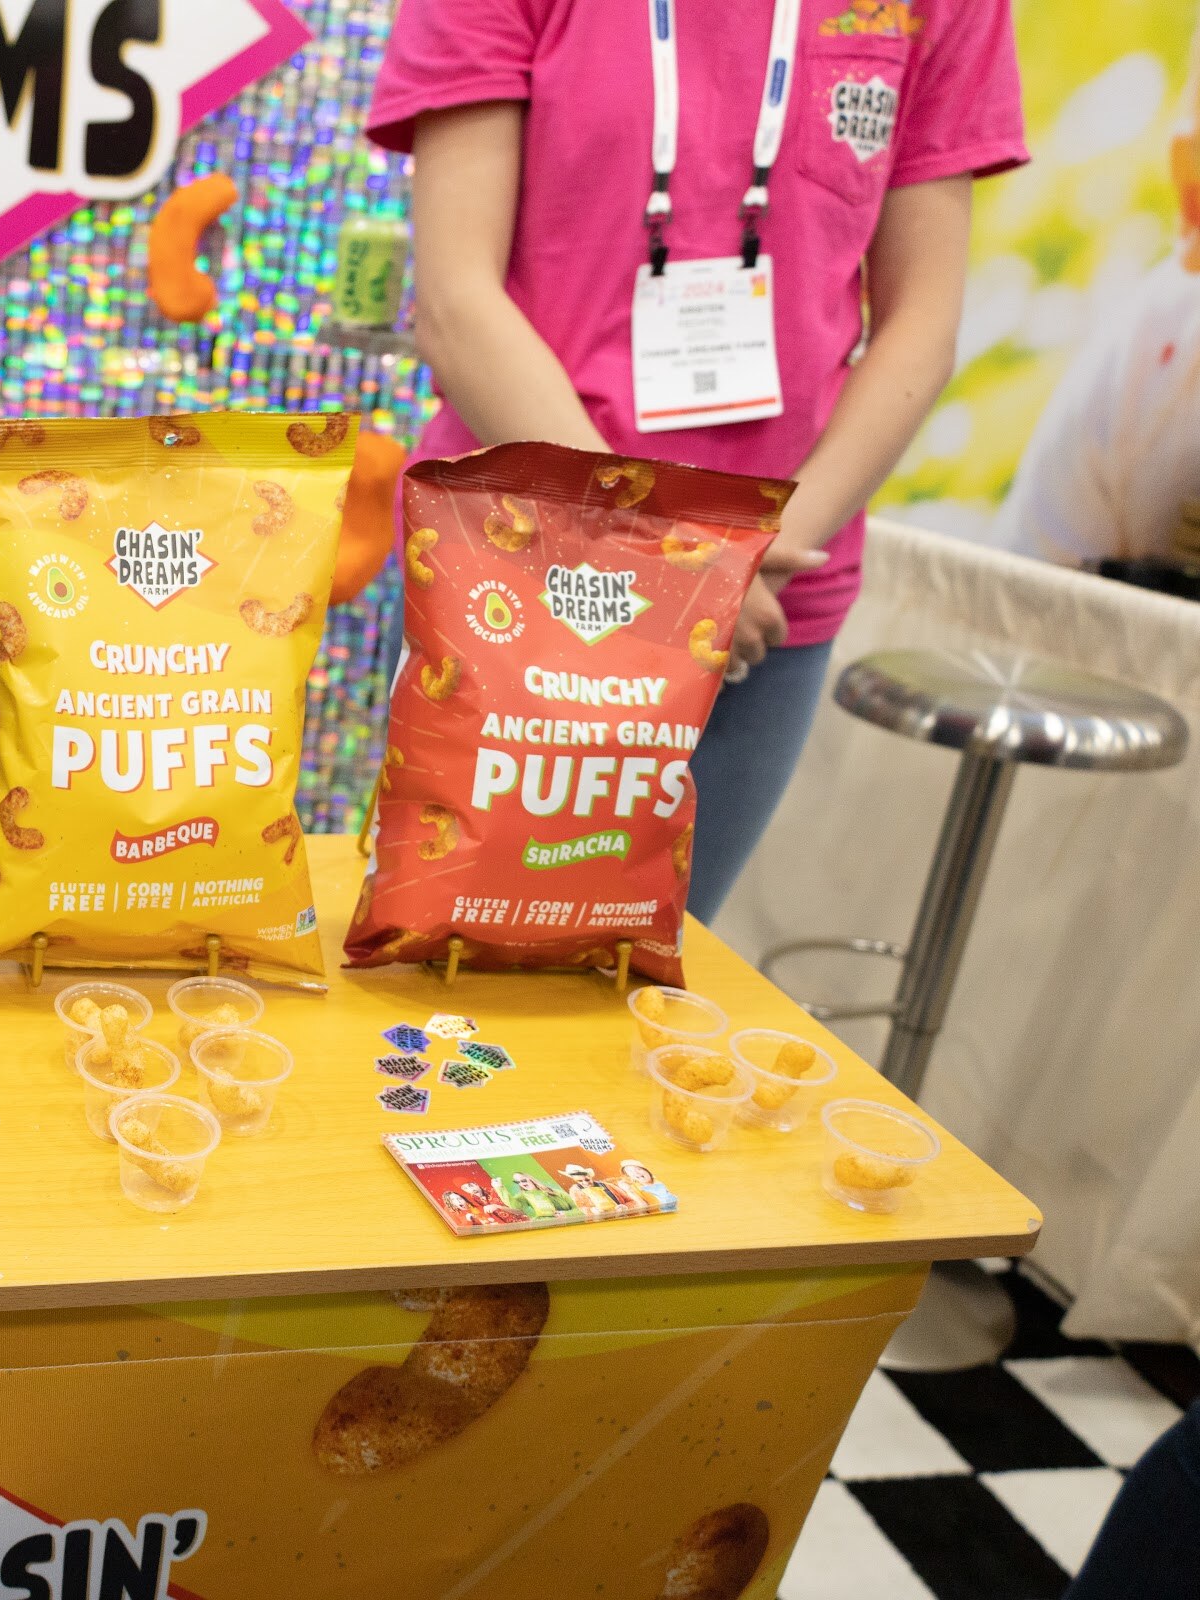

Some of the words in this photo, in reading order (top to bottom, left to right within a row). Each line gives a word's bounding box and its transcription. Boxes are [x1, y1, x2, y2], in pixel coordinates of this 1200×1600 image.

[115, 529, 201, 559] CHASIN'
[28, 553, 58, 577] MADE
[60, 553, 87, 580] WITH
[119, 560, 198, 585] DREAMS
[142, 587, 170, 596] FARM
[468, 580, 497, 601] MADE
[497, 581, 523, 609] WITH
[548, 567, 635, 599] CHASIN'
[27, 591, 76, 619] AVOCADO
[75, 595, 89, 611] OIL
[552, 599, 632, 624] DREAMS
[464, 614, 513, 644] AVOCADO
[512, 621, 526, 638] OIL
[575, 622, 602, 632] FARM
[89, 639, 231, 676] CRUNCHY
[524, 666, 668, 707] CRUNCHY
[55, 688, 172, 719] ANCIENT
[181, 687, 273, 716] GRAIN
[481, 712, 609, 748] ANCIENT
[617, 720, 700, 751] GRAIN
[51, 724, 273, 793] PUFFS
[470, 747, 690, 820] PUFFS
[115, 822, 214, 860] BARBEQUE
[526, 834, 626, 866] SRIRACHA
[49, 882, 105, 894] GLUTEN
[127, 882, 173, 898] CORN
[193, 877, 264, 896] NOTHING
[49, 894, 105, 912] FREE
[126, 897, 172, 909] FREE
[192, 892, 260, 908] ARTIFICIAL
[455, 896, 510, 910] GLUTEN
[528, 900, 573, 915] CORN
[591, 899, 658, 916] NOTHING
[451, 907, 506, 924] FREE
[524, 912, 570, 927] FREE
[587, 915, 654, 928] ARTIFICIAL
[396, 1128, 512, 1151] SPROUTS
[520, 1133, 557, 1147] FREE
